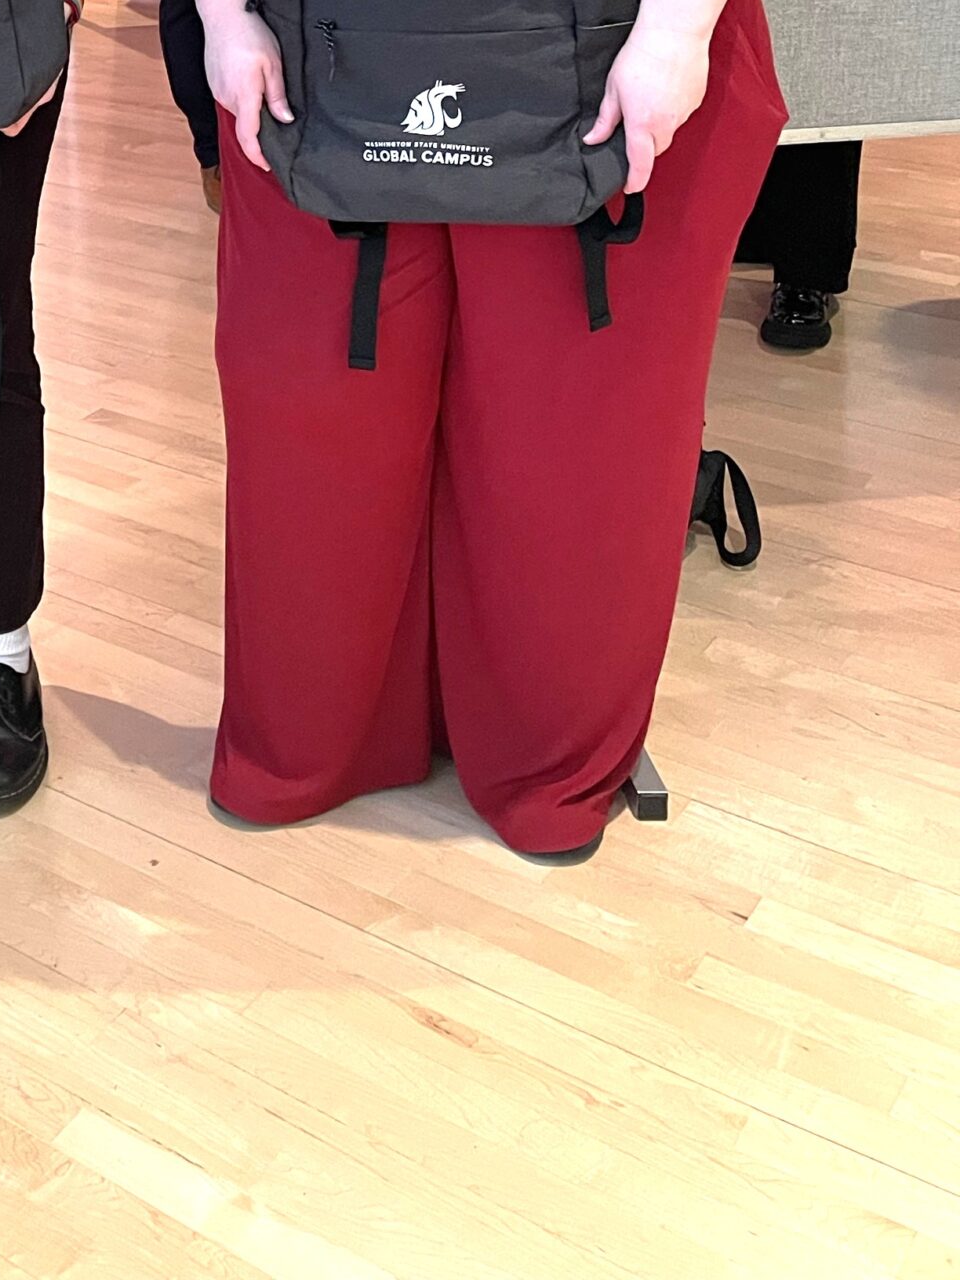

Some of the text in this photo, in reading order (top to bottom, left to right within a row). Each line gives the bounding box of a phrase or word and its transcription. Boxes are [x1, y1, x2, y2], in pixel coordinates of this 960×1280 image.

[414, 141, 438, 149] STATE
[440, 143, 490, 153] UNIVERSITY
[362, 149, 494, 167] GLOBAL CAMPUS
